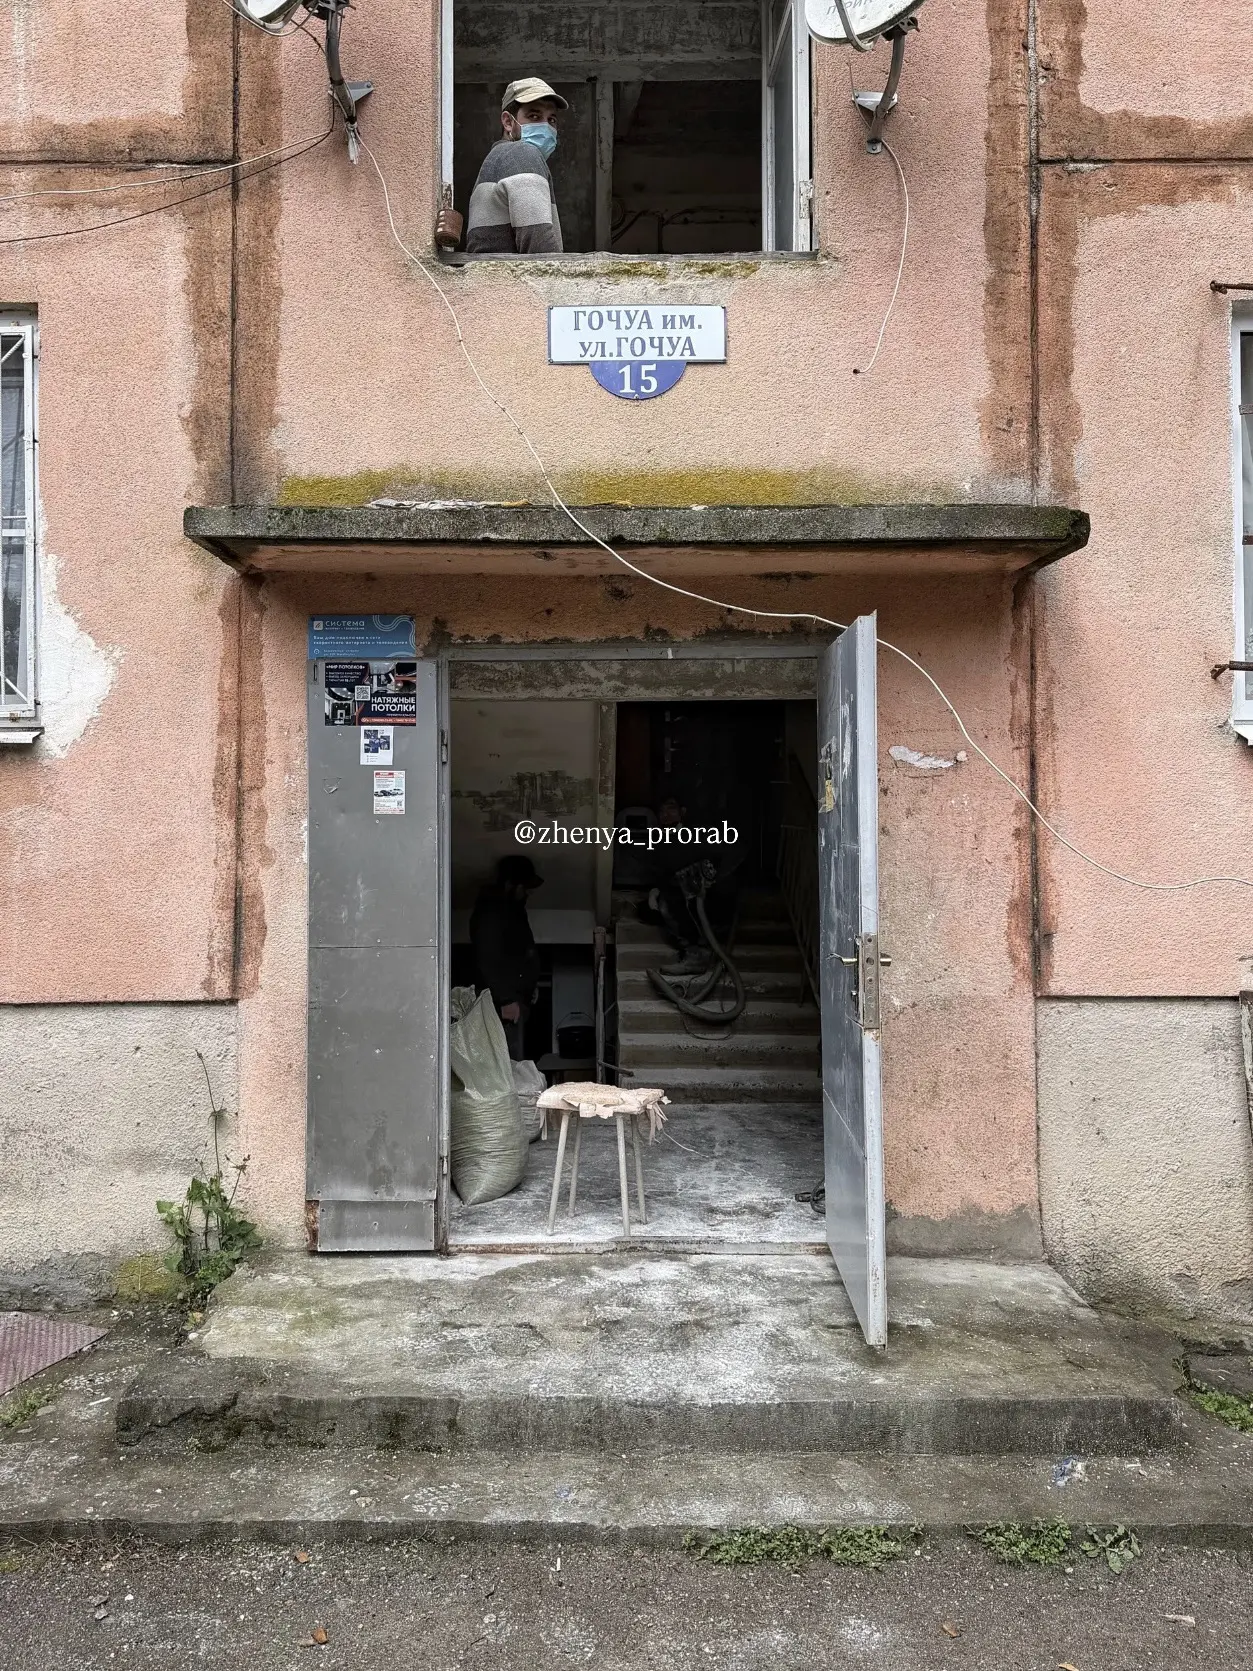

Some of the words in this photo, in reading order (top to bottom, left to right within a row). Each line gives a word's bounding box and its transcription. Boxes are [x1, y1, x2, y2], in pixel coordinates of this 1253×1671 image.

[573, 309, 654, 331] ГОЧУА
[661, 314, 703, 330] им.
[578, 336, 697, 358] ул.ГОЧУА
[618, 363, 658, 394] 15
[371, 696, 416, 704] НАТЯЖНЫЕ
[371, 704, 416, 712] ПОТОЛКИ
